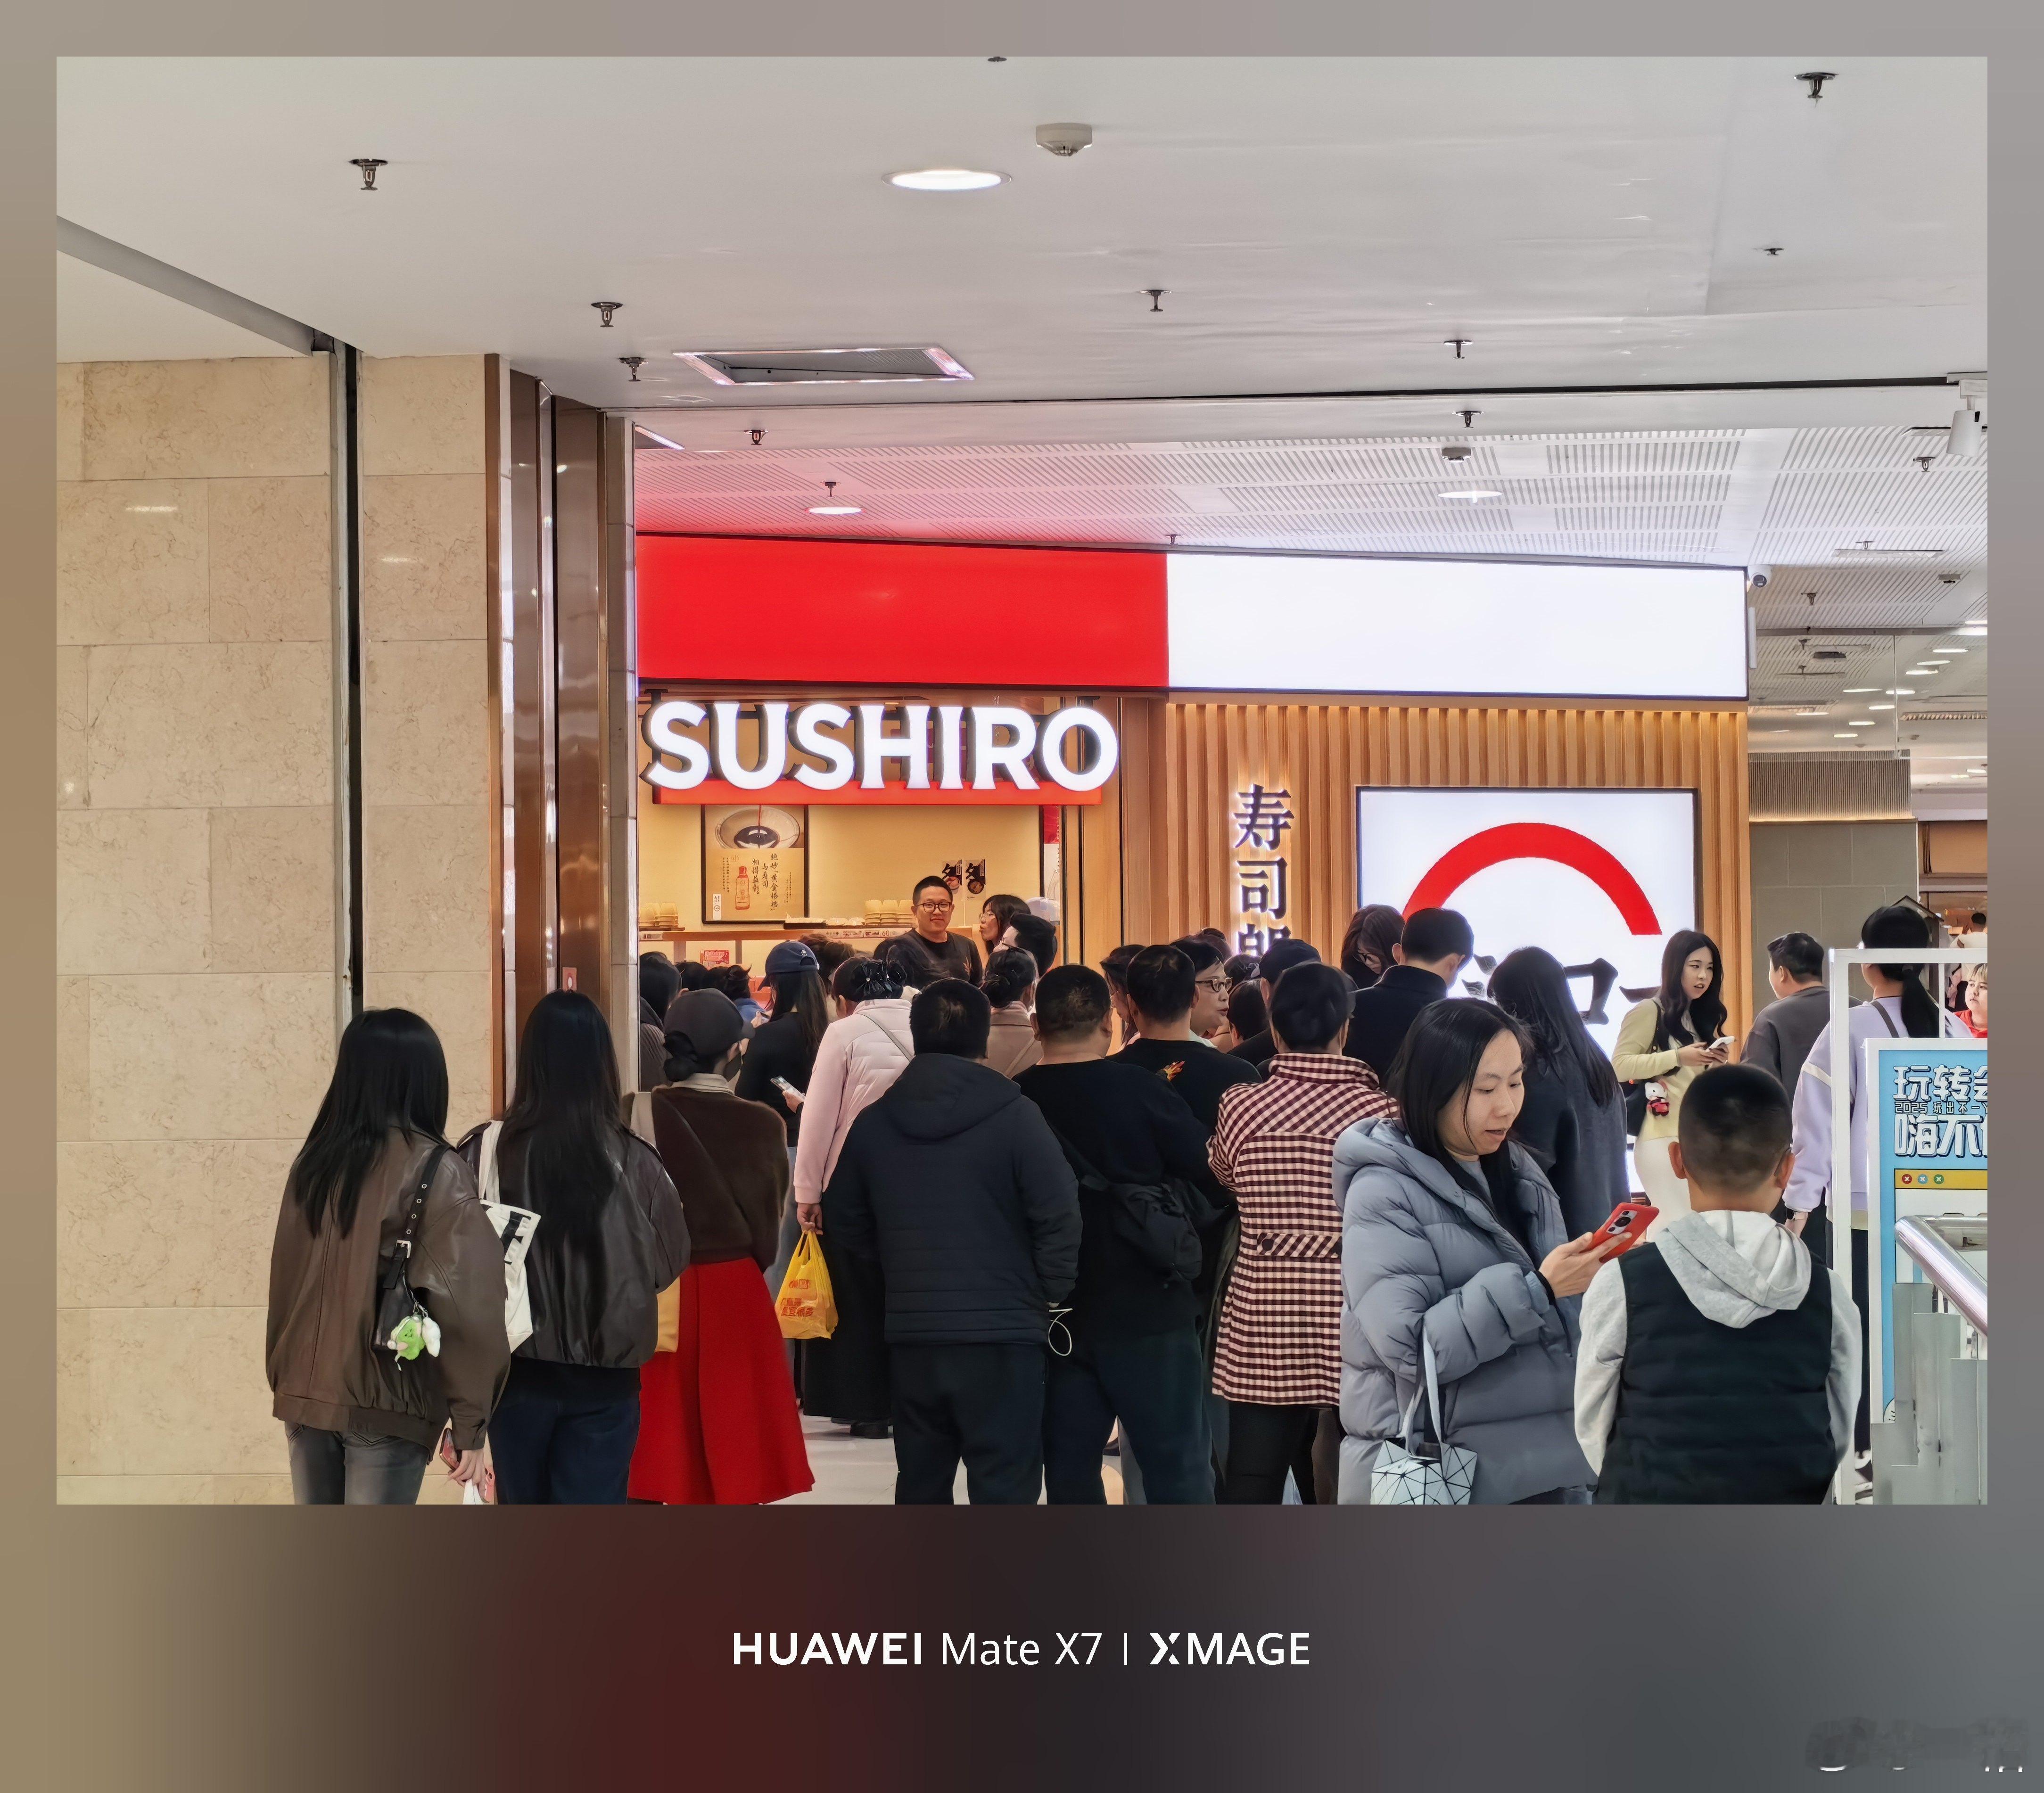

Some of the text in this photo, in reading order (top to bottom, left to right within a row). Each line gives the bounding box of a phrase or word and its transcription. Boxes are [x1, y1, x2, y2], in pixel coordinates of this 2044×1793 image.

[645, 700, 1119, 791] SUSHIRO
[1895, 1101, 1928, 1114] 2025
[1894, 1113, 1987, 1159] 嗨不
